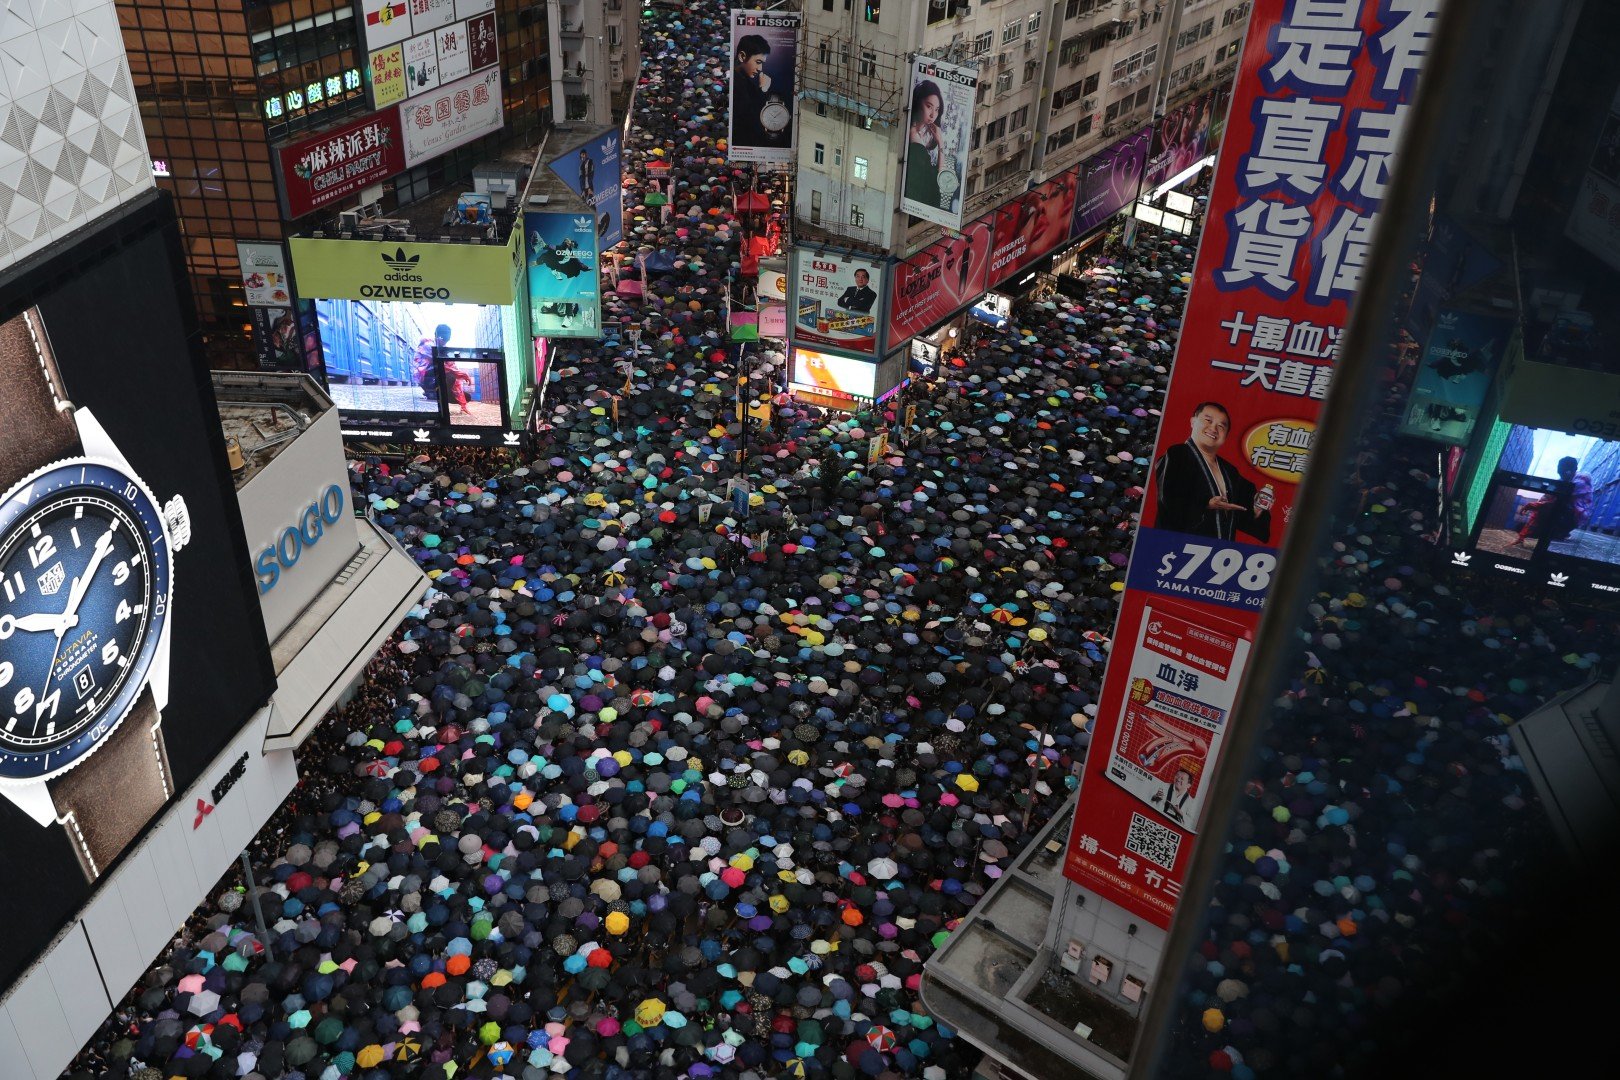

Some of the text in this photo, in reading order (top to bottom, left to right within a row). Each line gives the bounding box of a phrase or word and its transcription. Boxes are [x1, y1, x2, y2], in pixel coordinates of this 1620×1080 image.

[757, 18, 797, 27] TISSOT
[936, 68, 974, 86] TISSOT
[415, 83, 490, 130] 花園餐廳
[310, 123, 380, 174] 麻辣派對
[601, 152, 618, 165] adidas
[1222, 0, 1363, 292] 是真貨
[313, 151, 382, 191] CHILI PARTY
[586, 183, 618, 207] OZWEEGO
[555, 249, 593, 257] OZWEEGO
[991, 244, 1027, 272] COLOURS
[993, 235, 1026, 259] POWERFUL
[384, 272, 423, 283] adidas
[927, 266, 942, 281] ME
[360, 284, 450, 300] OZWEEGO
[124, 481, 138, 501] 10
[28, 534, 57, 569] 12
[256, 483, 344, 594] SOGO
[39, 563, 62, 587] TAG
[112, 560, 130, 586] 3
[115, 598, 132, 625] 4
[155, 593, 166, 616] 20
[55, 630, 93, 666] AUTAVIA
[101, 638, 119, 666] 5
[57, 643, 97, 681] CHRONOMETER
[79, 673, 89, 690] 8
[1156, 662, 1199, 691] 血淨
[14, 686, 35, 715] 8
[91, 717, 109, 742] 30
[1119, 732, 1130, 753] BLOOD
[1125, 710, 1136, 732] CLEAN
[1079, 834, 1138, 875] 掃一掃
[1089, 863, 1132, 890] mannings
[1143, 892, 1175, 912] mannin
